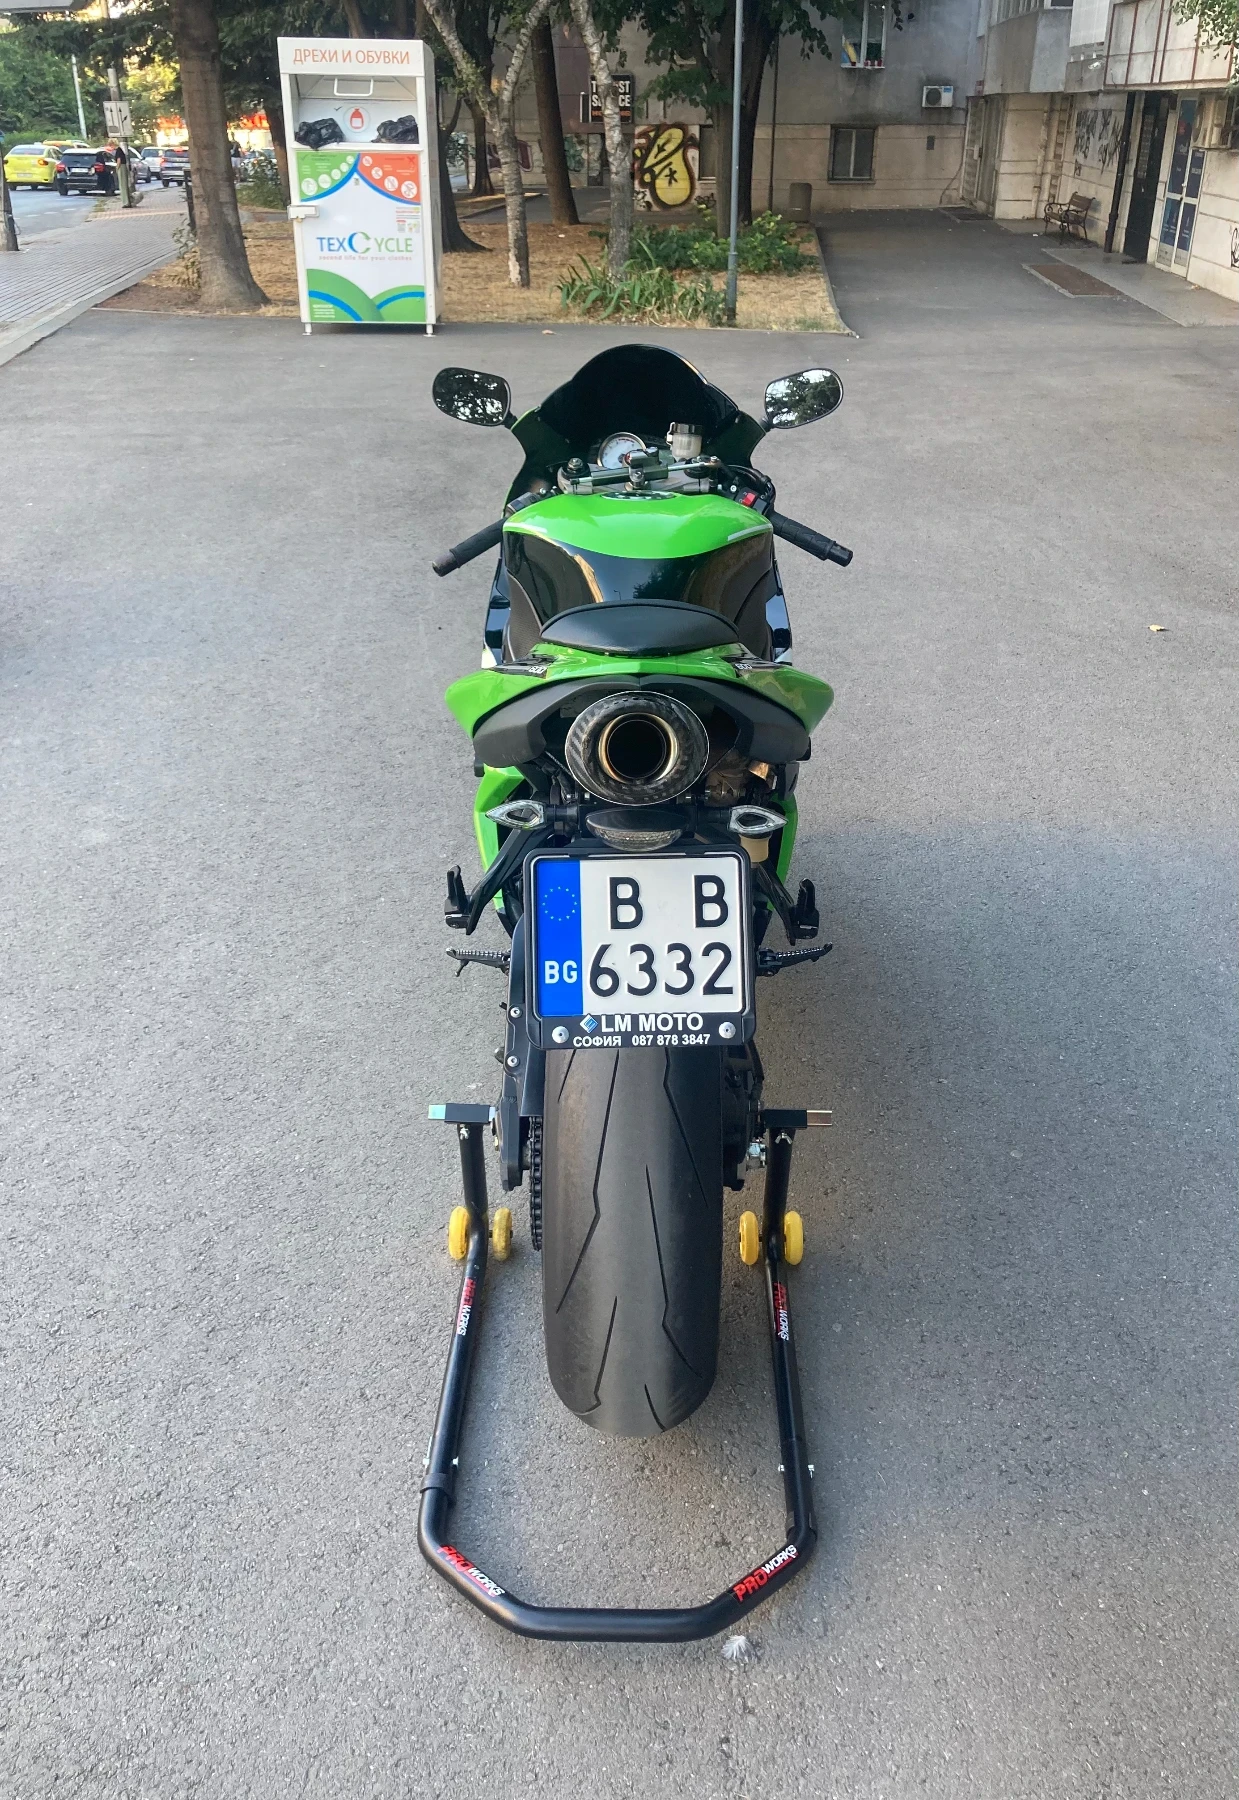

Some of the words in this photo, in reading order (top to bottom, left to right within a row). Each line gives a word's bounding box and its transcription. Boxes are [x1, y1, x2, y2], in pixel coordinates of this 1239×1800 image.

[293, 48, 338, 65] ДРЕХИ
[342, 49, 352, 63] И
[355, 49, 410, 65] ОБУВКИ
[316, 231, 413, 254] TEXCYCLE
[609, 876, 644, 930] B
[693, 874, 729, 928] B
[544, 960, 578, 984] BG
[589, 941, 734, 997] 6332
[601, 1014, 632, 1033] LM
[638, 1012, 704, 1032] MOTO
[573, 1035, 622, 1047] СОФИЯ
[631, 1034, 654, 1046] 087
[656, 1034, 679, 1046] 878
[681, 1033, 711, 1045] 3847
